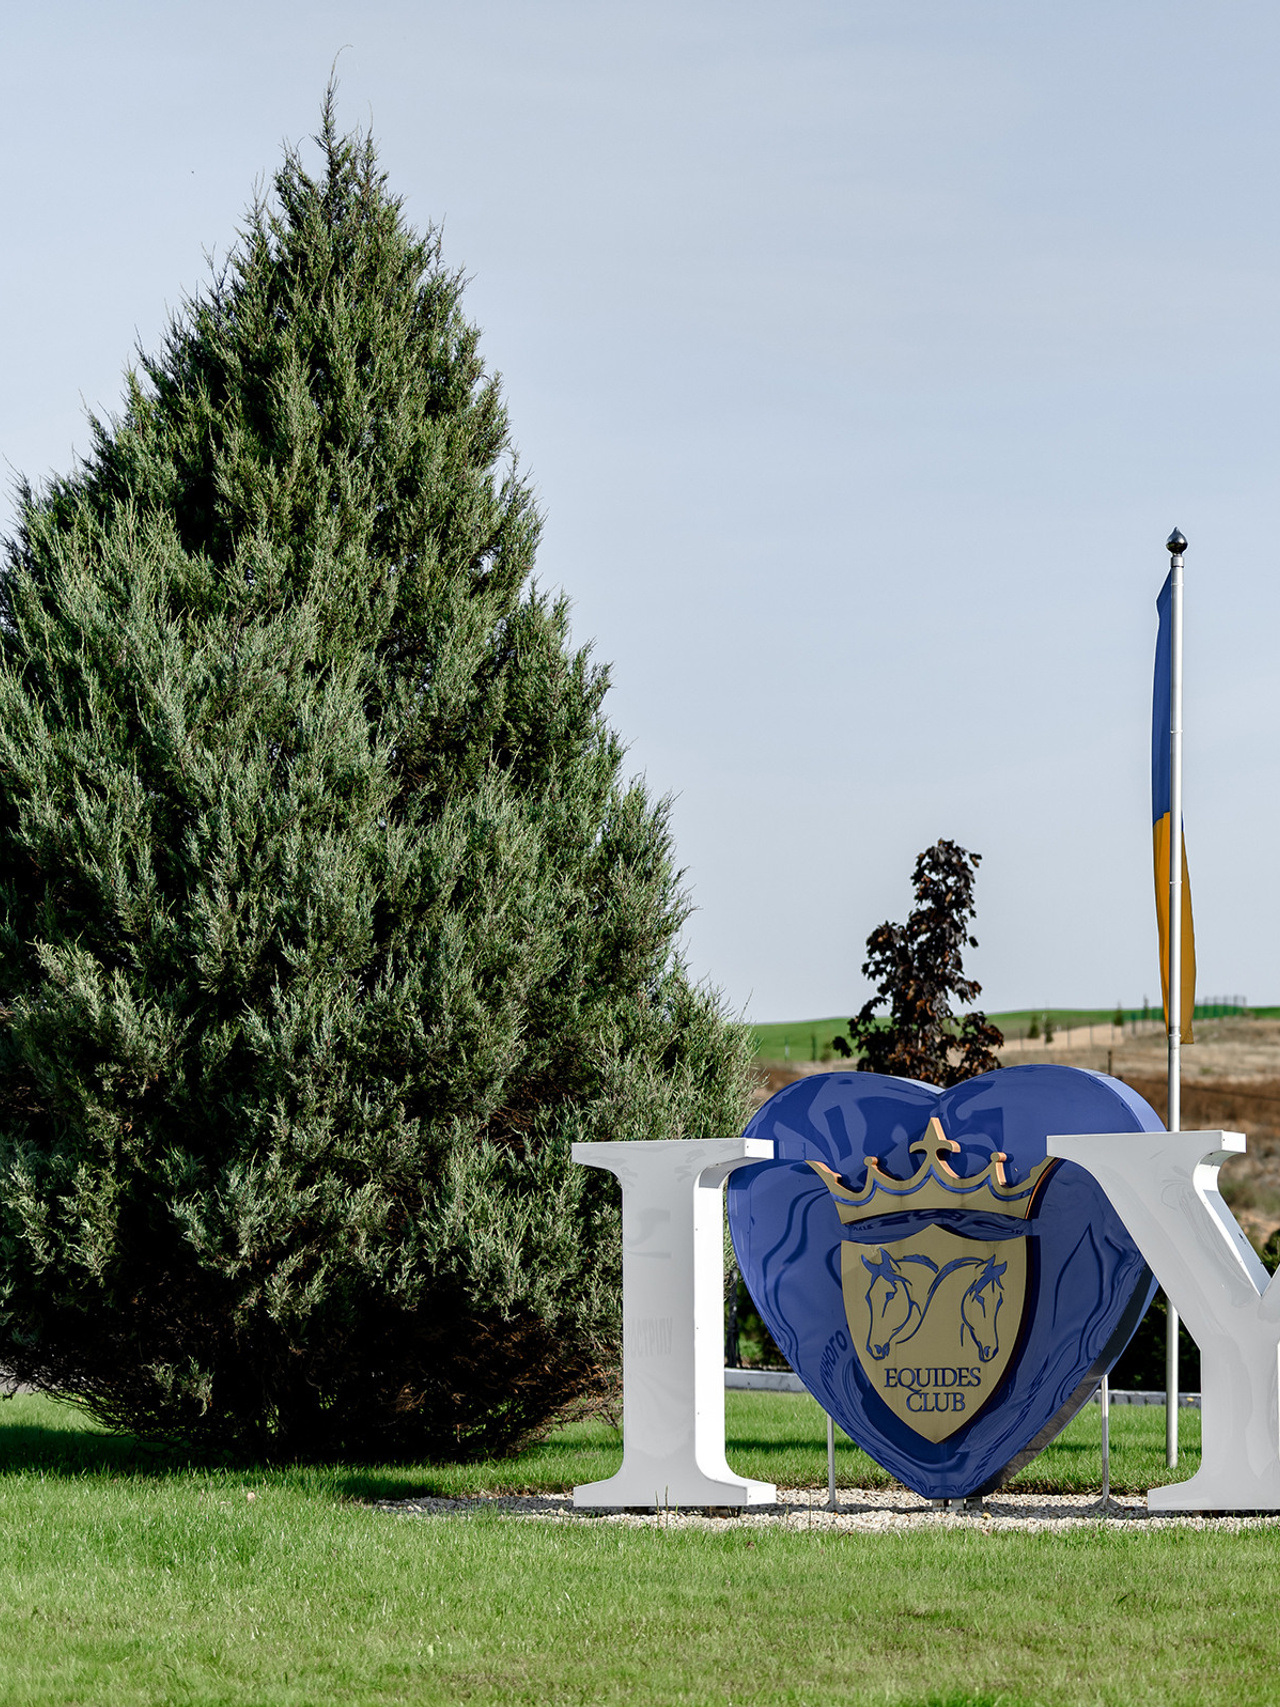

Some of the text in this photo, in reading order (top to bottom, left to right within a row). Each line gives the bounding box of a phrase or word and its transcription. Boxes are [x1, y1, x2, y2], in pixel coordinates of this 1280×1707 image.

[571, 1138, 777, 1507] I
[884, 1367, 982, 1393] EQUIDES
[906, 1392, 966, 1413] CLUB
